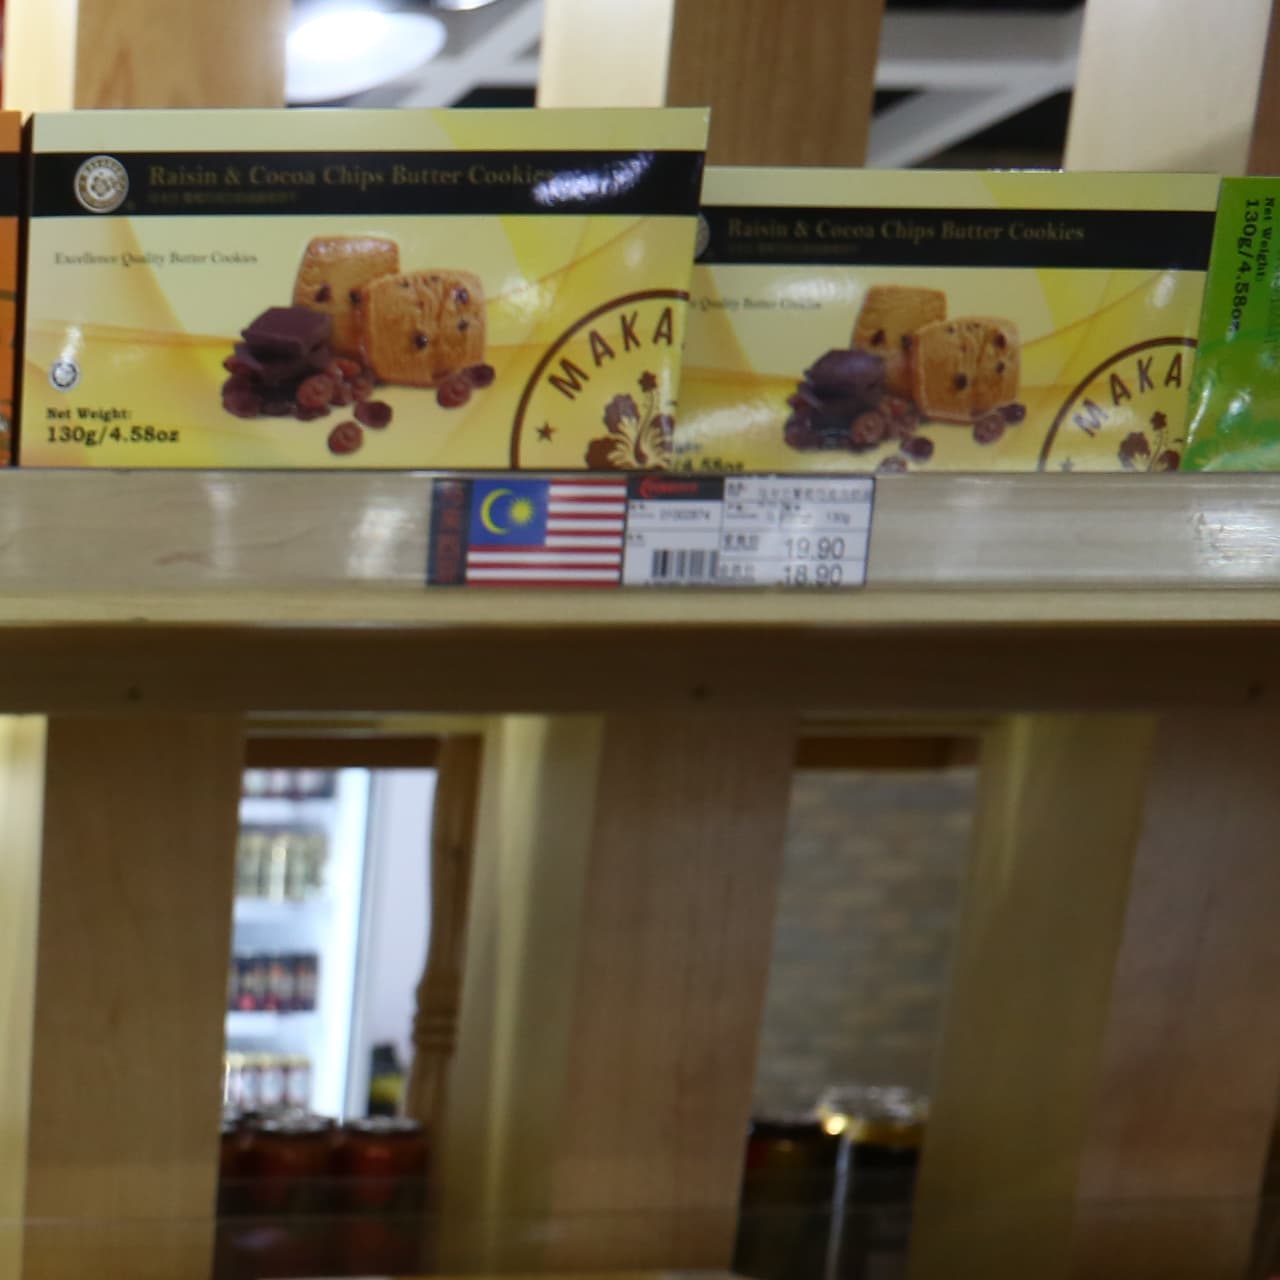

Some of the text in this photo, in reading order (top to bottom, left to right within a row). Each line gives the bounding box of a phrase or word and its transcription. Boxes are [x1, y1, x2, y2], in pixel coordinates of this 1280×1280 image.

[148, 165, 219, 187] Raisin
[249, 165, 316, 186] Cocoa
[322, 164, 384, 191] Chips
[390, 164, 461, 186] Butter
[728, 218, 789, 239] Raisin
[816, 220, 874, 240] Cocoa
[881, 220, 936, 245] Chips
[941, 221, 1004, 242] Butter
[1009, 222, 1085, 242] Cookies
[46, 425, 180, 446] 130g/4.58oz
[784, 536, 845, 559] 19.90
[783, 565, 843, 585] 18.90
